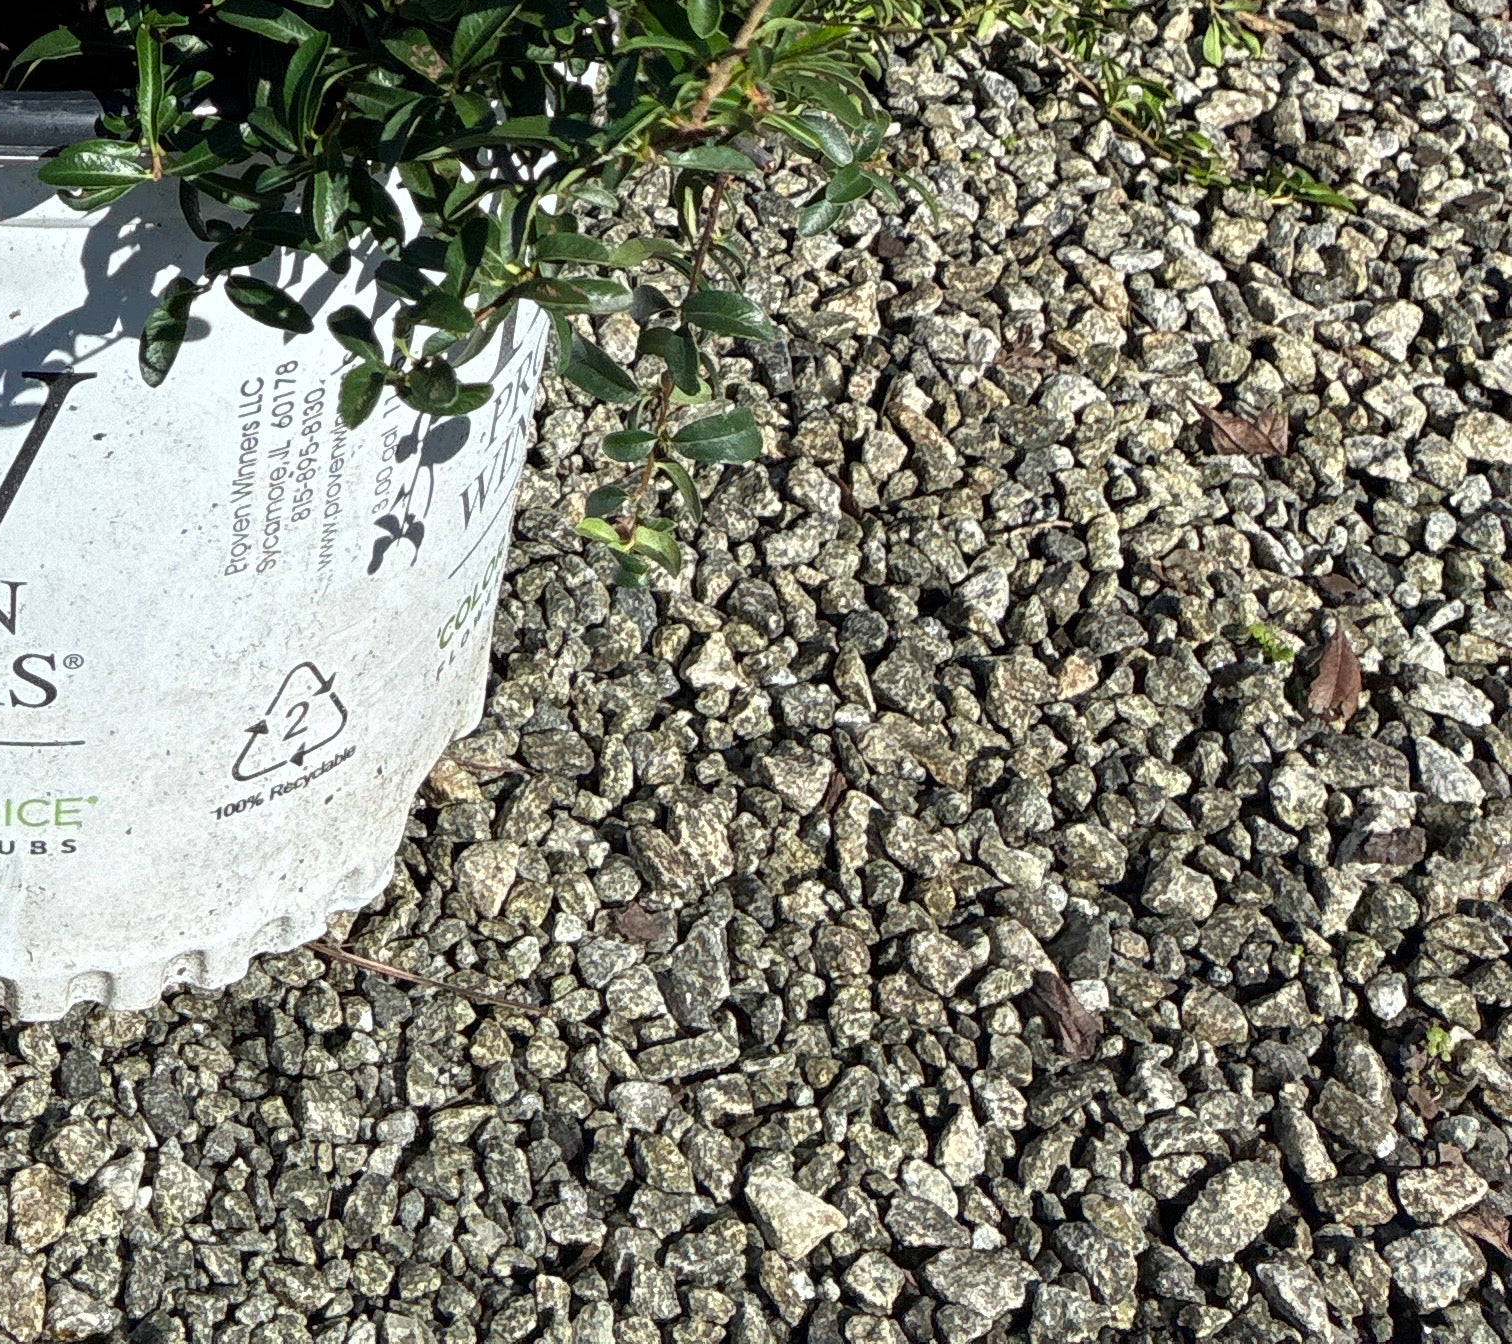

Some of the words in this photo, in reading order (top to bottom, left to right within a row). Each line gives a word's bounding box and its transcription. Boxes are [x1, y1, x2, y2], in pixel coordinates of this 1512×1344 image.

[238, 377, 264, 418] LLC
[270, 360, 299, 429] 60178
[230, 420, 261, 504] Winners
[291, 387, 326, 523] 815-895-8130
[381, 425, 399, 463] gal
[372, 465, 393, 514] 3.00
[224, 503, 252, 576] Proven
[282, 700, 310, 742] 2
[210, 791, 265, 820] 100%
[269, 744, 357, 801] Recyclable
